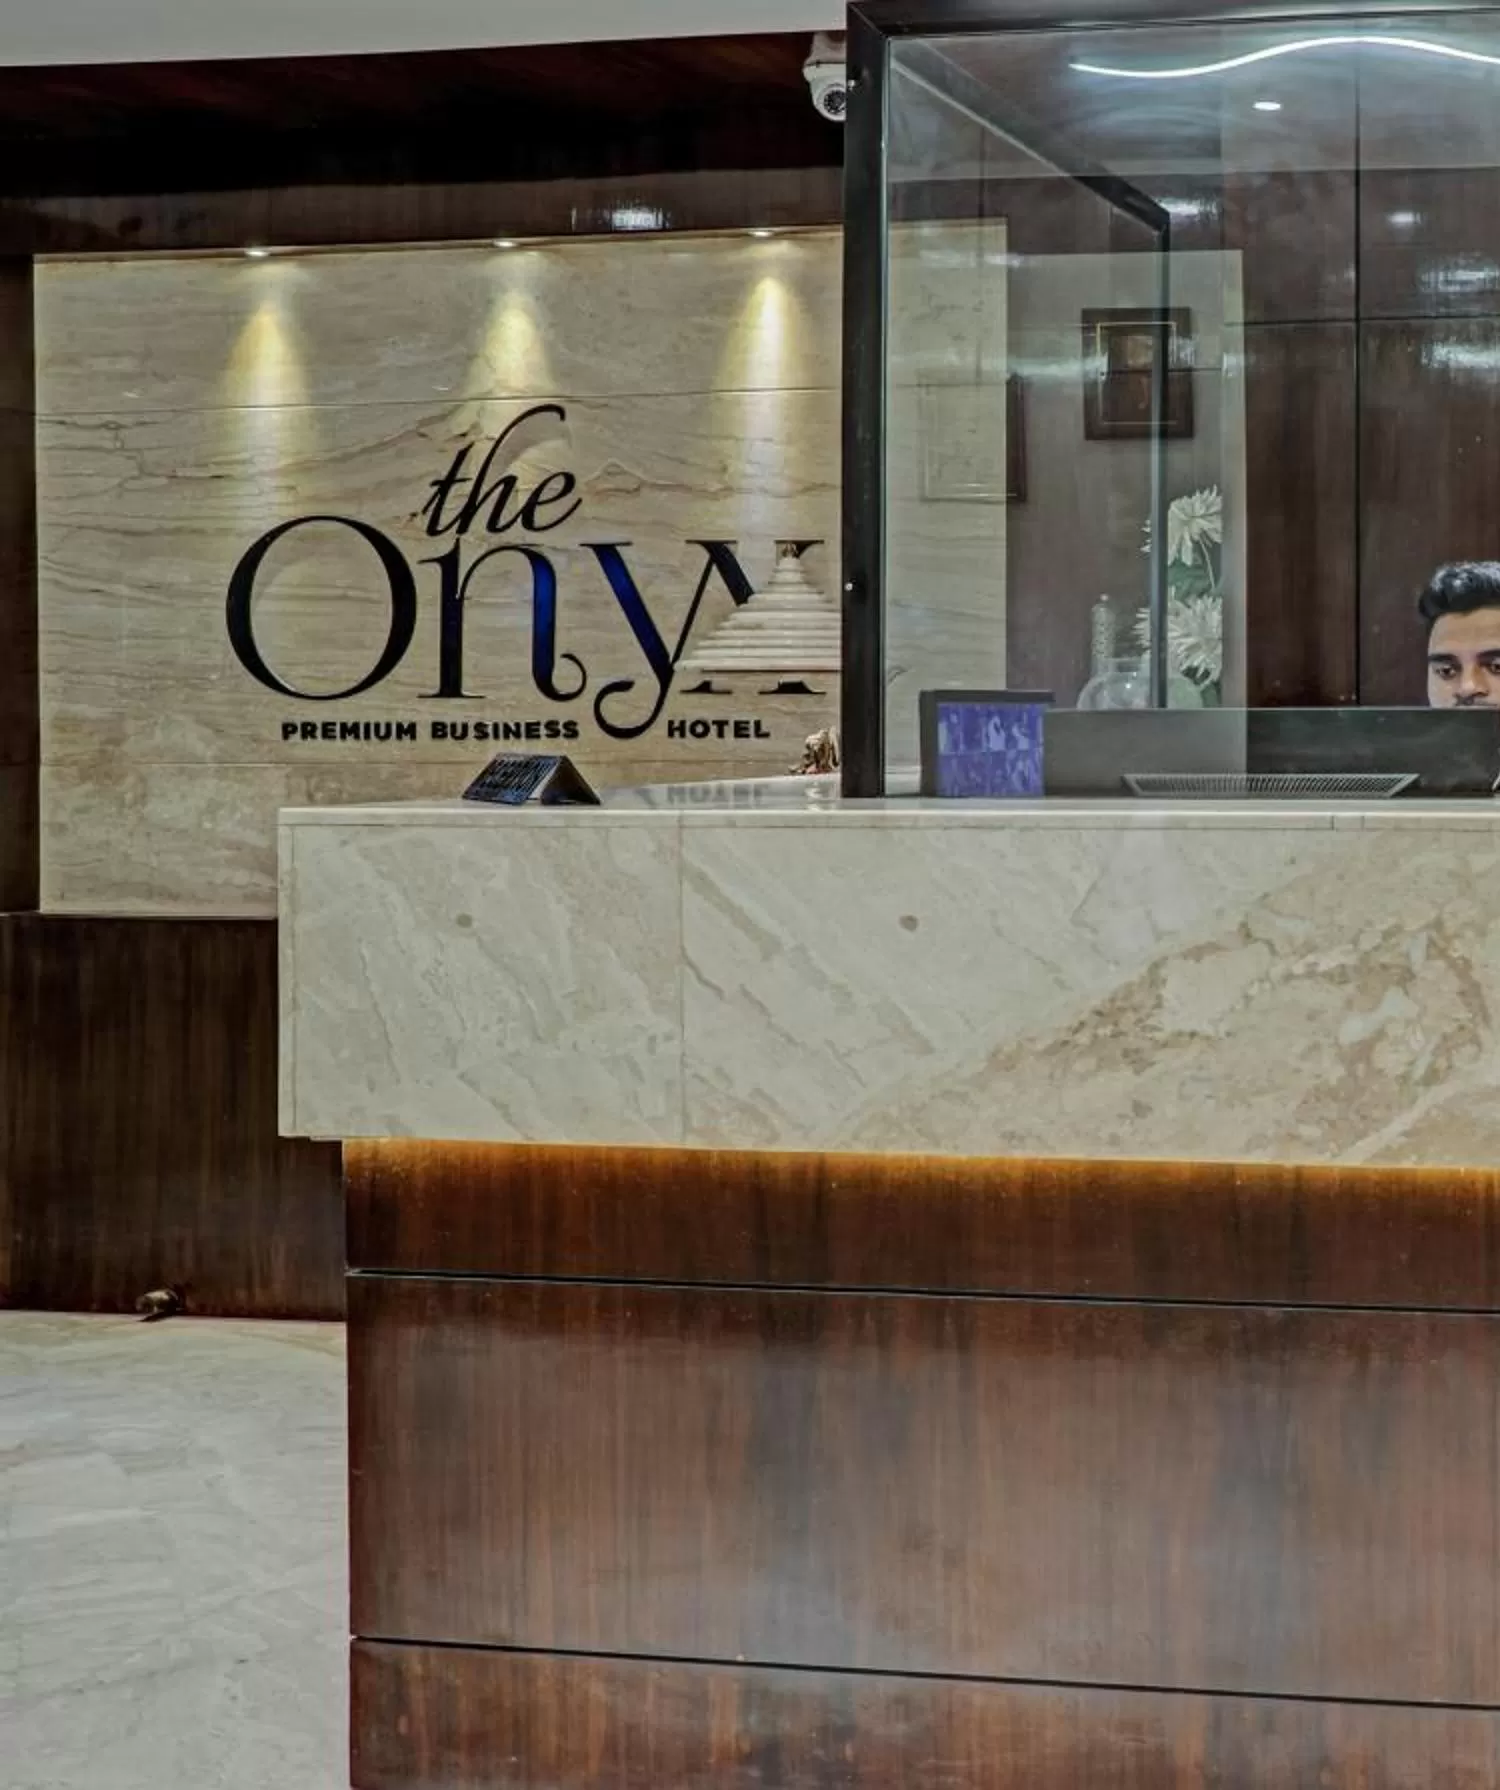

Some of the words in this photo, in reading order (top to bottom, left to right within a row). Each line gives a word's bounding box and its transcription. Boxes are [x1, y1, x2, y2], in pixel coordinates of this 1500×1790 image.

[421, 403, 583, 537] the
[281, 720, 417, 742] PREMIUM
[431, 718, 580, 741] BUSINESS
[667, 719, 771, 739] HOTEL
